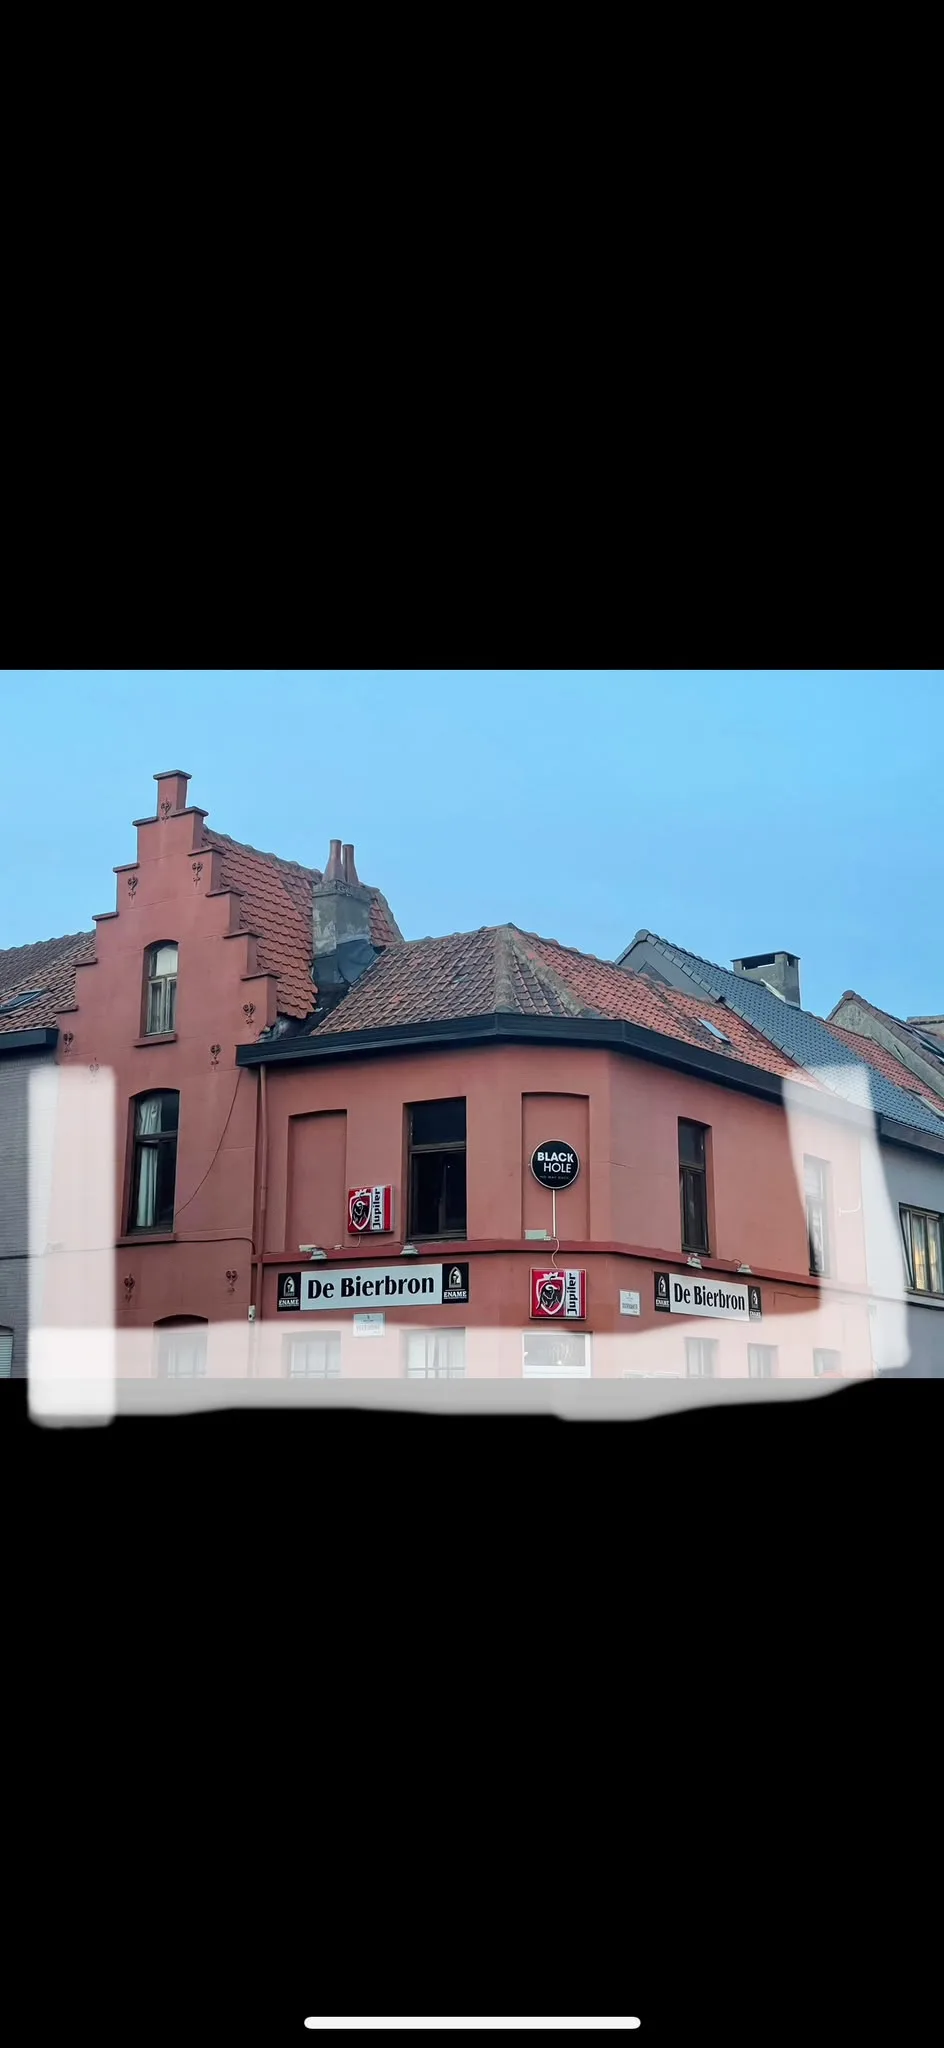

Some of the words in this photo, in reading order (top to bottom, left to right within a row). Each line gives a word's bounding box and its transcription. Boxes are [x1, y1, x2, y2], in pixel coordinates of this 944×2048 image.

[537, 1152, 574, 1163] BLACK
[543, 1162, 572, 1173] HOLE
[372, 1188, 382, 1228] Jupiler
[307, 1279, 334, 1300] De
[340, 1275, 434, 1297] Bierbron
[566, 1272, 578, 1315] Jupiler
[673, 1283, 691, 1304] De
[693, 1285, 746, 1311] Bierbron
